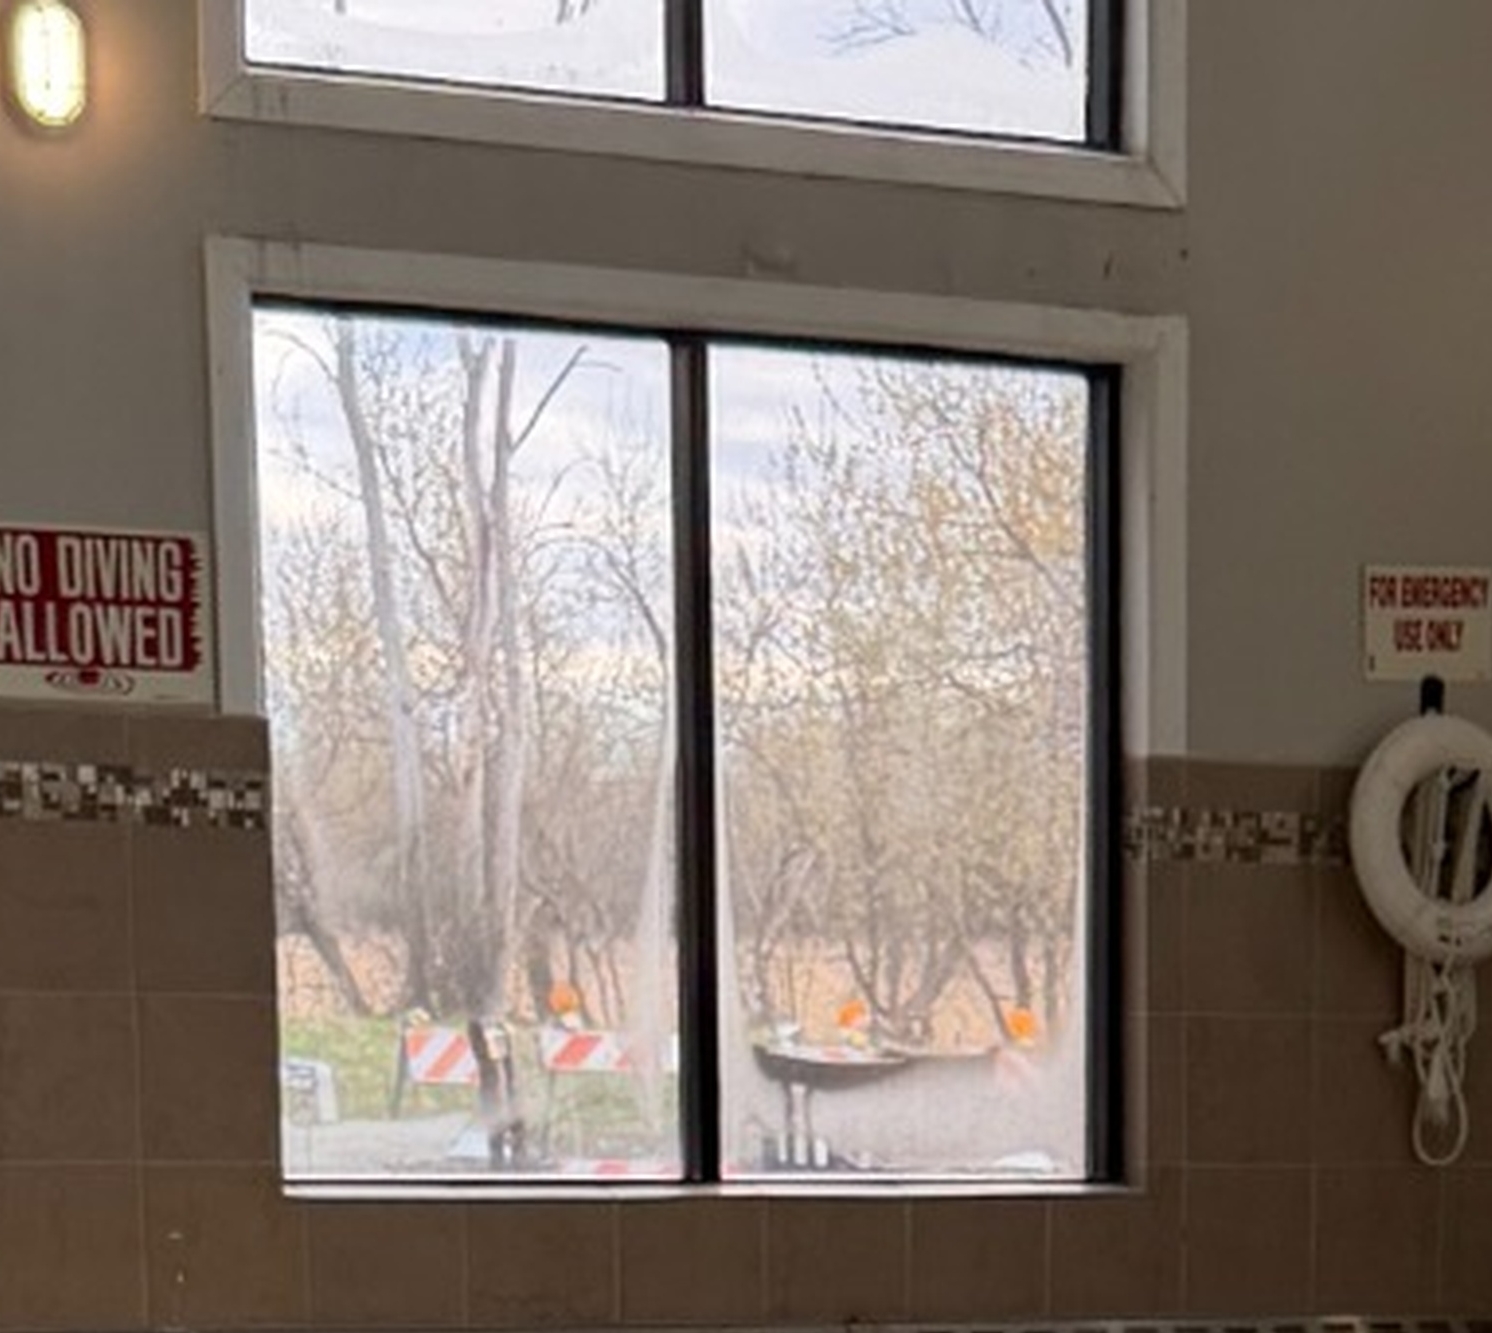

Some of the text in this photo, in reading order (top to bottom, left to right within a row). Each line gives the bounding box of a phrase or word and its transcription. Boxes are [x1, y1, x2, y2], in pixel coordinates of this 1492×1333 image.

[57, 535, 184, 602] DIVING
[1370, 576, 1489, 609] FOR EMERGENCY
[1394, 619, 1464, 652] USE ONLY
